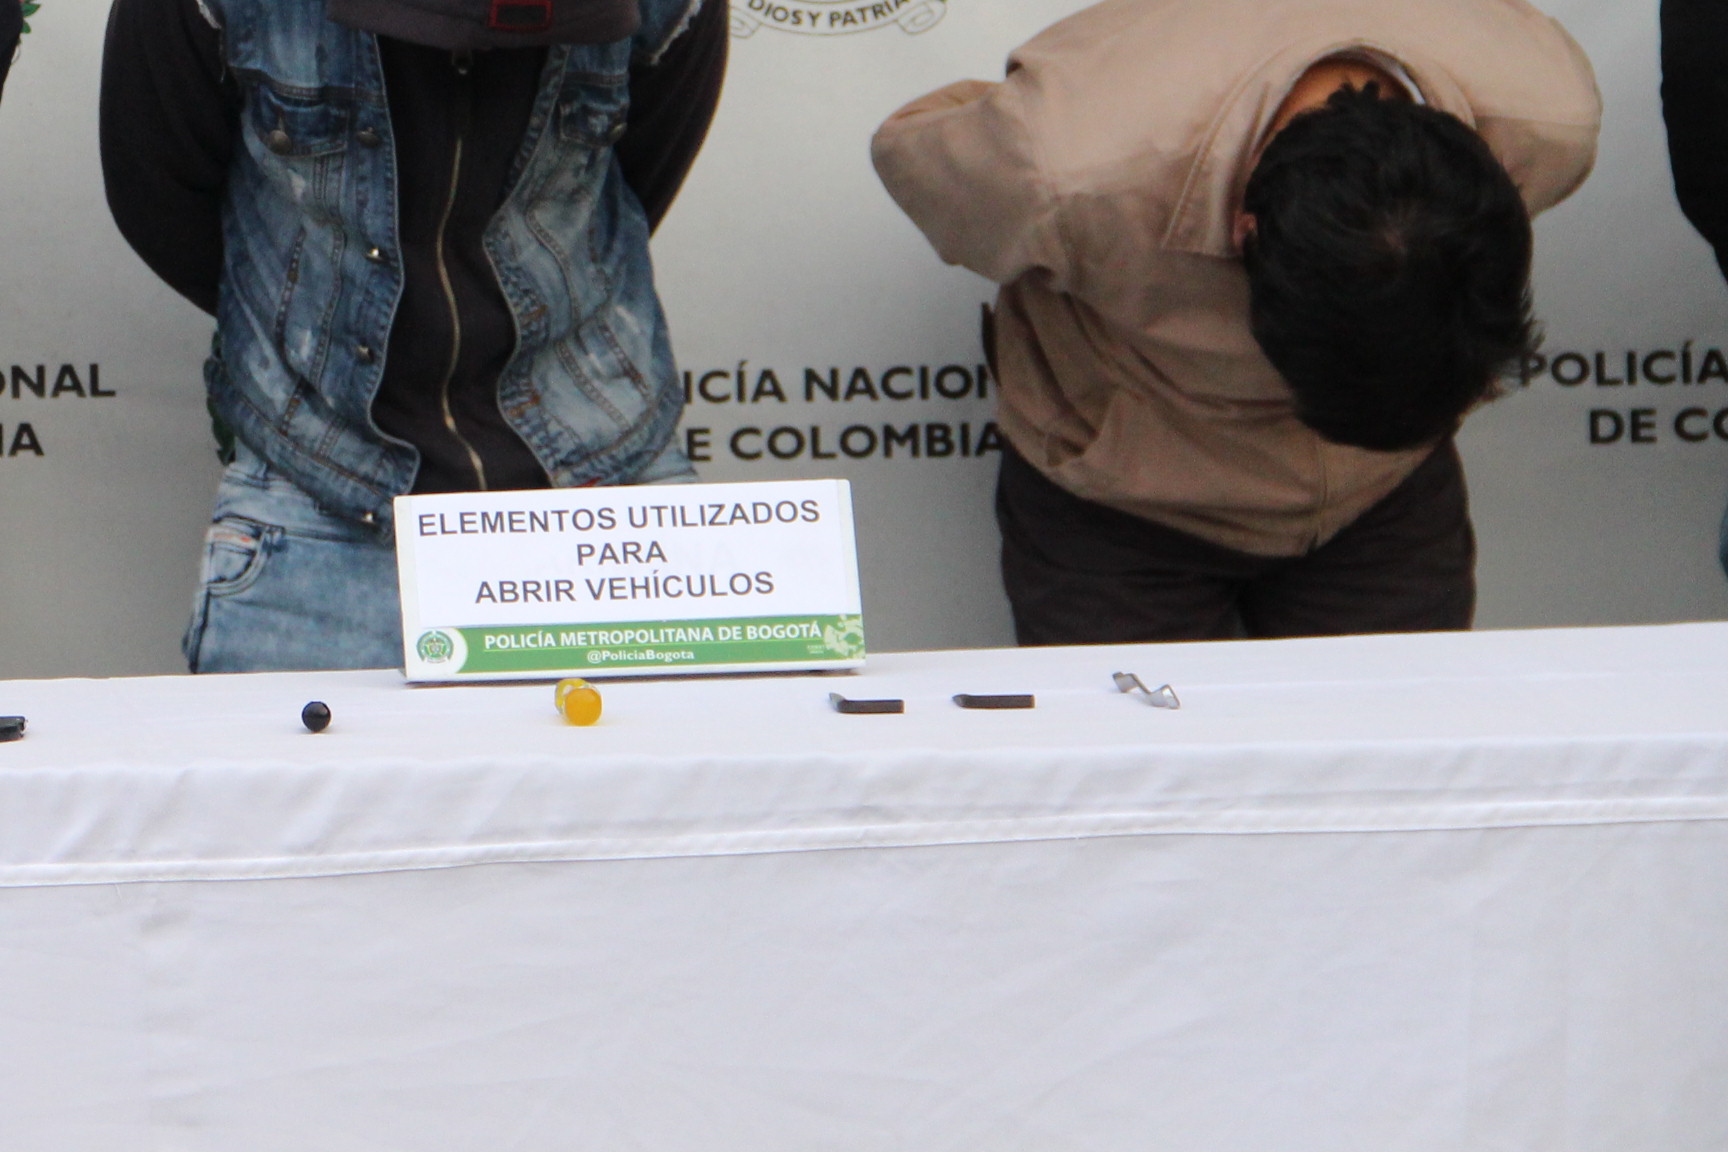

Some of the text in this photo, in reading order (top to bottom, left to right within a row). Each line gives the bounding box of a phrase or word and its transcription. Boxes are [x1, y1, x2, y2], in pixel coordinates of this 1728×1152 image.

[683, 360, 989, 404] ICÍA NACIO
[729, 422, 1004, 461] COLOMBIA
[1590, 408, 1657, 444] DE
[418, 499, 820, 537] ELEMENTOS UTILIZADOS
[576, 540, 667, 567] PARA
[475, 570, 774, 605] ABRIR VEHÍCULOS
[484, 619, 822, 650] POLICÍA METROPOLITANA DE BOGOTÁ
[587, 647, 695, 665] @PoliciaBogota
